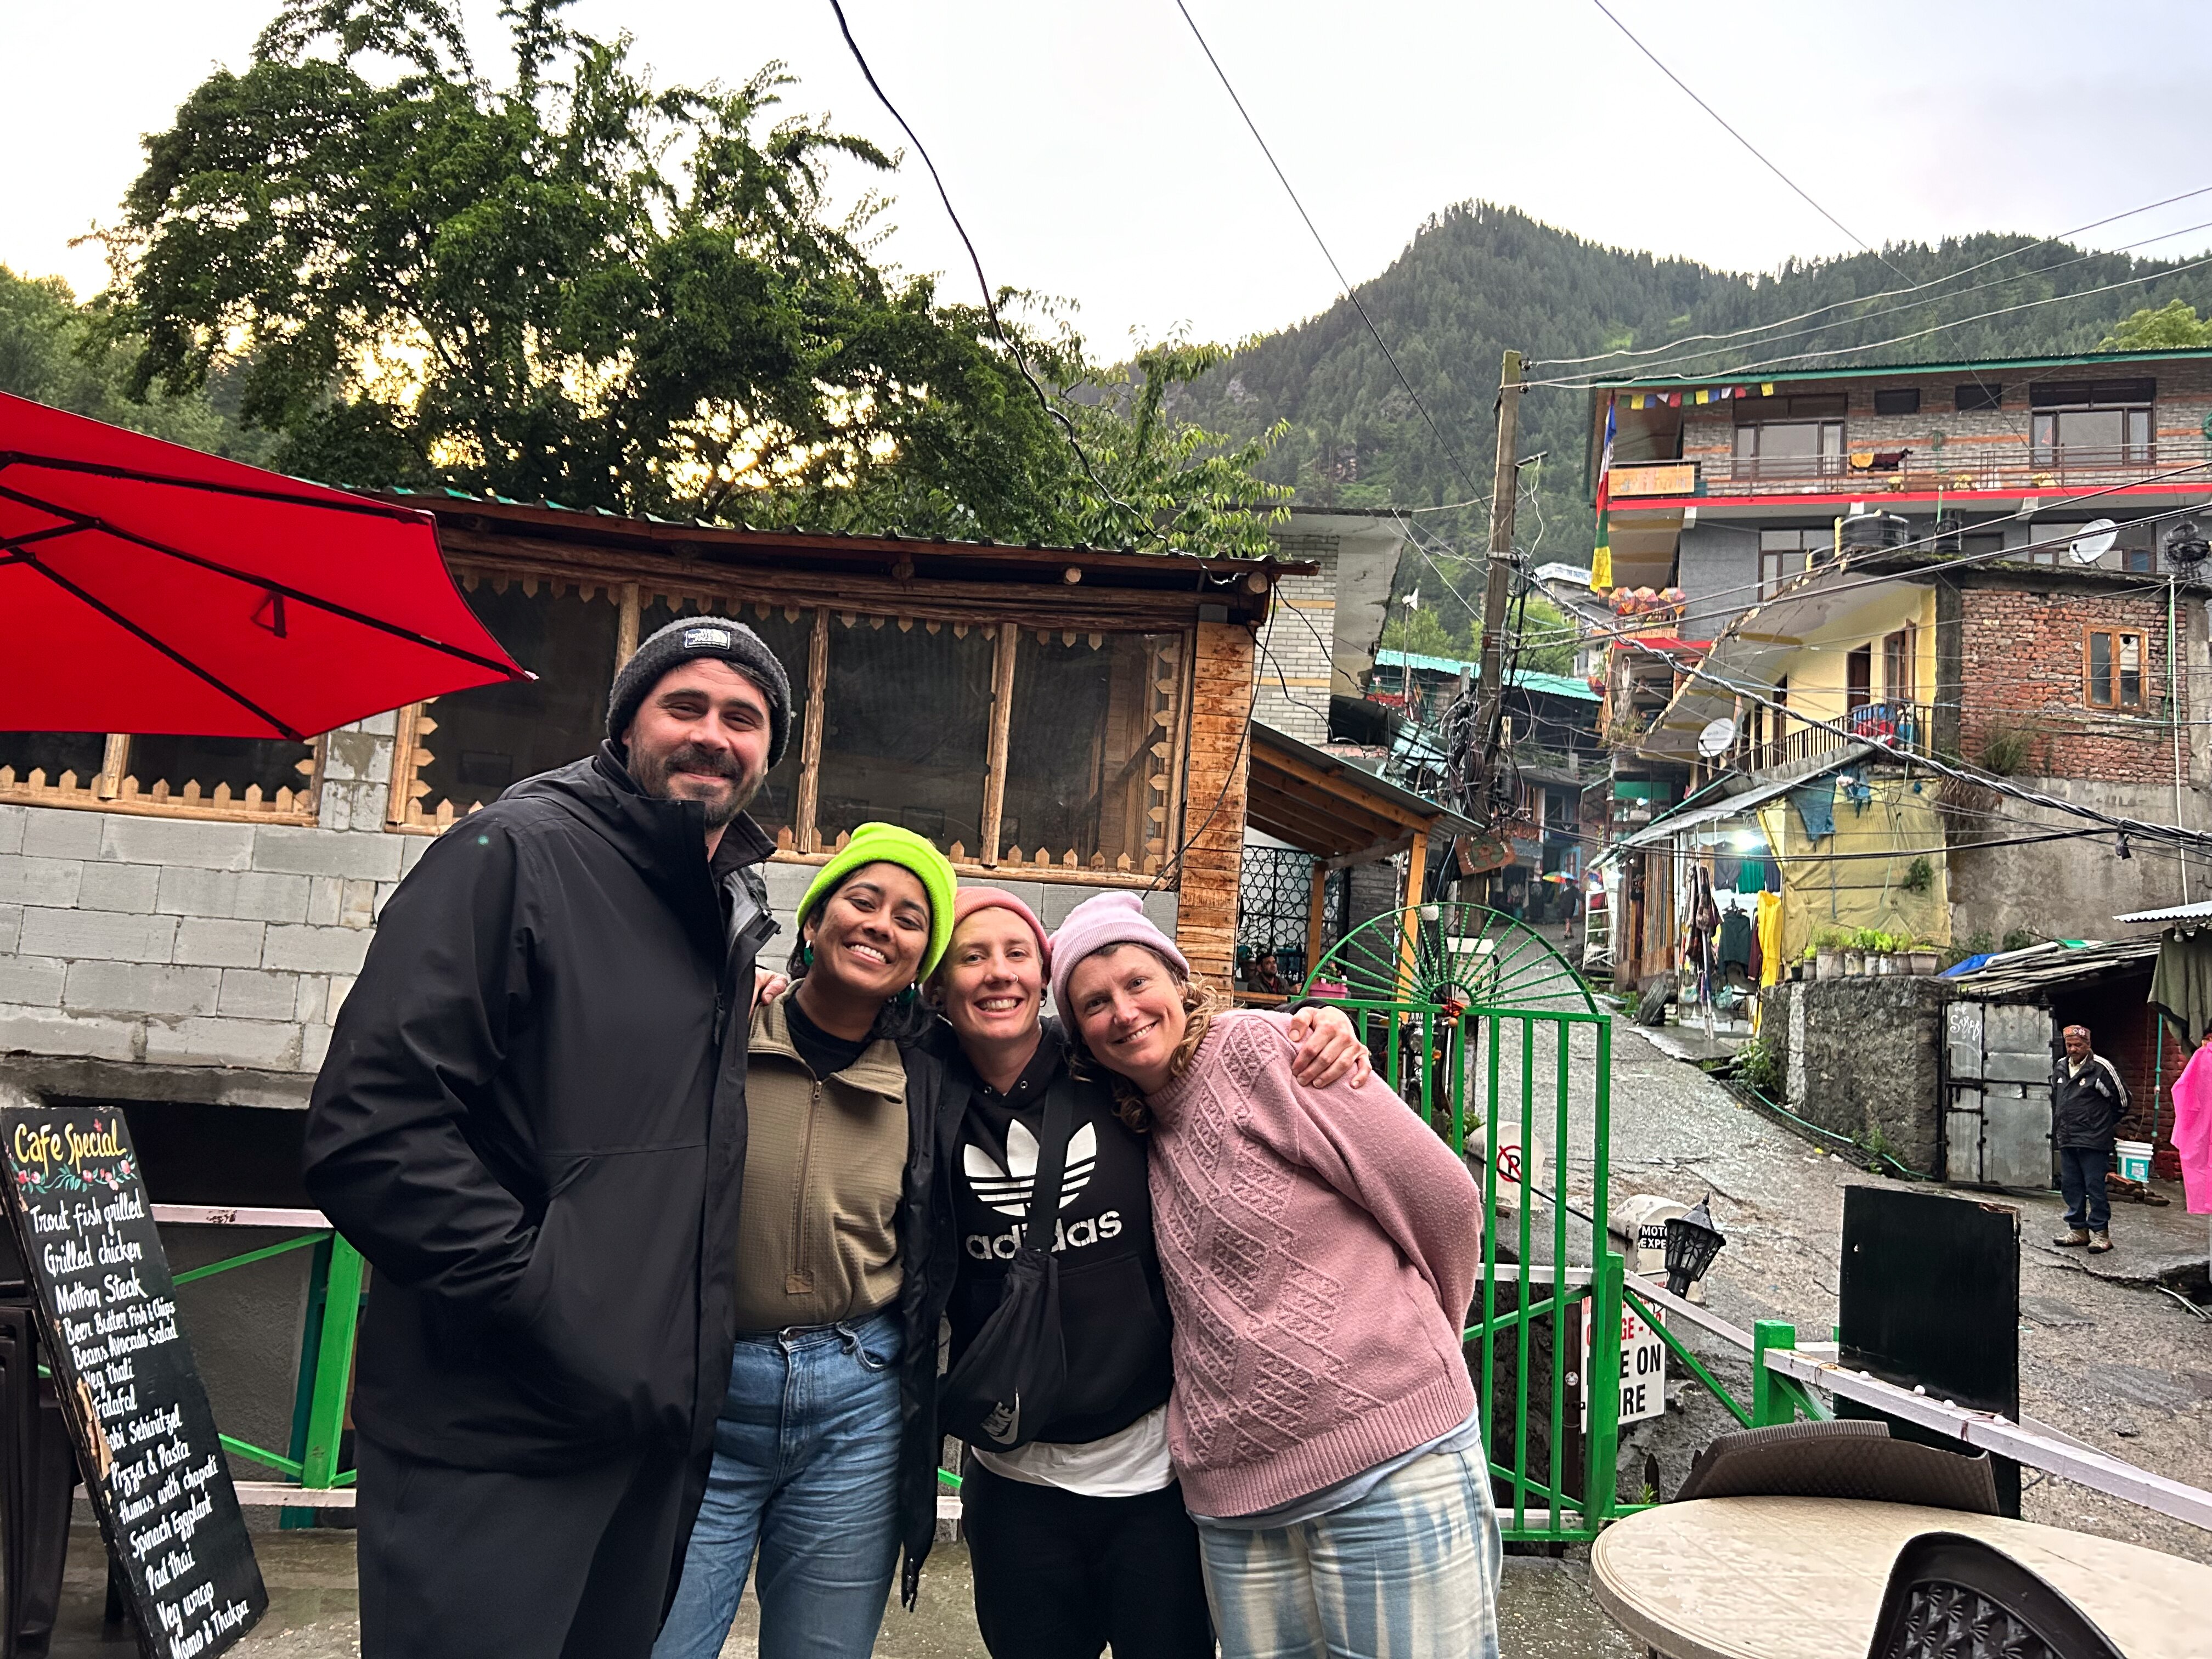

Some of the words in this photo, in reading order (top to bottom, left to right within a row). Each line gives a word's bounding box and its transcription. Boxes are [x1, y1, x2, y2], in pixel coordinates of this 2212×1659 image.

[15, 1123, 64, 1178] Cafe
[65, 1118, 127, 1174] Special
[30, 1200, 71, 1233] Trout
[73, 1197, 102, 1237] fish
[104, 1188, 145, 1236] grilled
[966, 1210, 1122, 1259] addas
[44, 1235, 94, 1277] Grilled
[98, 1230, 143, 1265] chicken
[1638, 1238, 1666, 1249] EXPE
[55, 1281, 101, 1314] Motton
[104, 1267, 149, 1303] Steak
[63, 1317, 94, 1345] Beer
[127, 1304, 148, 1328] Fish
[146, 1303, 154, 1322] &
[153, 1296, 176, 1322] Chips
[71, 1345, 109, 1370] Beans
[108, 1329, 148, 1357] Avocado
[148, 1318, 179, 1346] Salad
[83, 1370, 106, 1400] Veg
[105, 1357, 135, 1385] thali
[1637, 1344, 1661, 1375] ON
[110, 1462, 147, 1497] Pizza
[146, 1449, 159, 1475] &
[157, 1434, 191, 1469] Pasta
[119, 1494, 155, 1525] Humus
[157, 1471, 181, 1505] with
[183, 1454, 219, 1492] chapati
[129, 1514, 173, 1561] Spinach
[170, 1491, 213, 1542] Eggplant
[145, 1565, 171, 1595] Pad
[168, 1543, 195, 1579] thai
[156, 1600, 183, 1638] Veg
[183, 1581, 214, 1616] wrap
[170, 1633, 204, 1659] Momo
[202, 1620, 213, 1645] &
[211, 1599, 250, 1637] Thukpa
